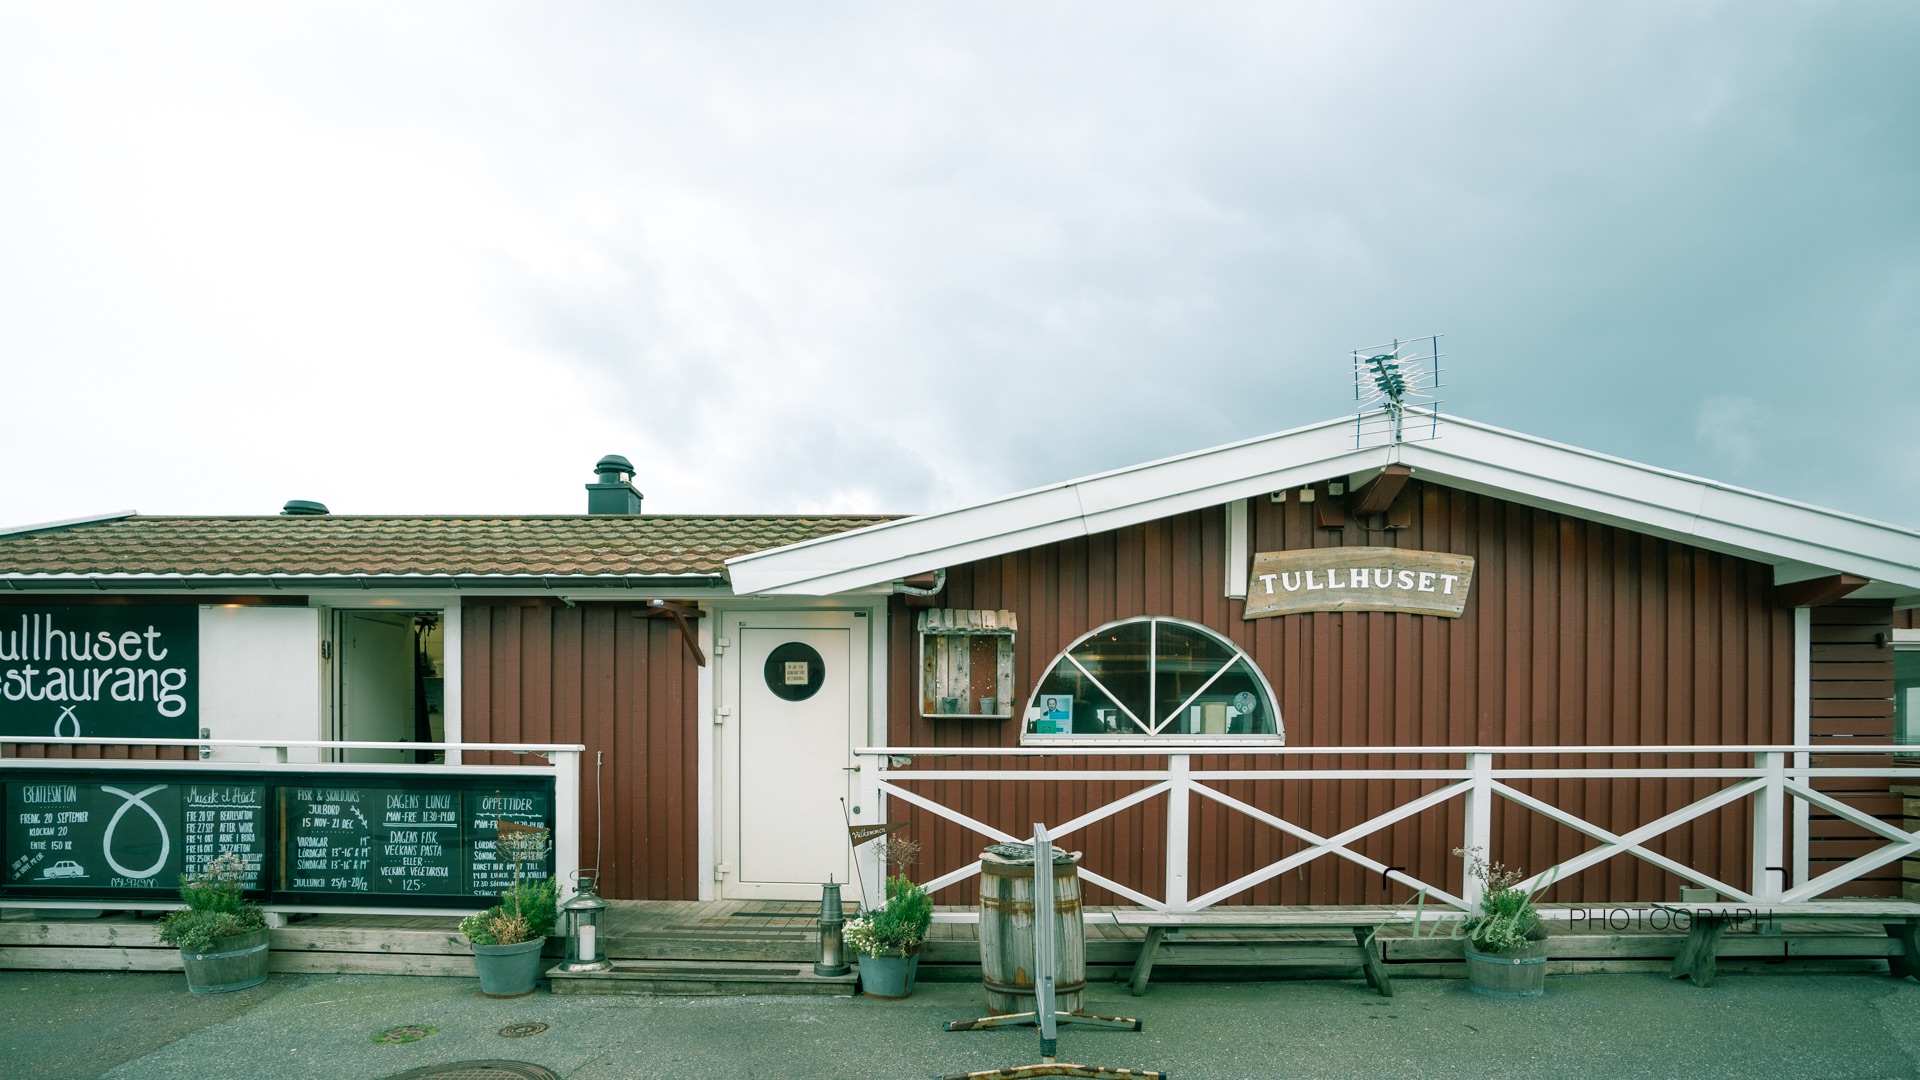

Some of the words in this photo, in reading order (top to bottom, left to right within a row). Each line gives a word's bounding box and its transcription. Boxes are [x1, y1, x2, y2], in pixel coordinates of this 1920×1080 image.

[1259, 568, 1459, 595] TULLHUSET
[0, 664, 187, 718] staurang
[23, 785, 77, 803] BEATLESAFTON
[187, 786, 219, 803] Musik
[297, 790, 313, 801] FISK
[316, 791, 323, 801] &
[386, 794, 420, 809] DAGENS
[425, 795, 451, 809] LUNCH
[482, 796, 533, 811] ÖPPETTIDER
[308, 804, 340, 815] JULBORD
[44, 813, 53, 824] 20
[57, 811, 89, 823] SEPTEMBER
[186, 811, 197, 822] FRE
[198, 811, 206, 822] 20
[206, 811, 216, 821] SEP
[220, 810, 253, 821] BEATLESAFTON
[386, 811, 417, 822] MÅN-FRE
[186, 823, 196, 833] FRE
[197, 823, 206, 833] 27
[205, 823, 215, 833] SEP
[219, 823, 236, 833] AFTER
[238, 823, 254, 833] WORK
[302, 818, 311, 827] 15
[332, 819, 340, 828] 21
[342, 819, 354, 829] DEC
[474, 819, 499, 831] MÅN-FR
[29, 827, 55, 837] KLOCKAN
[57, 826, 68, 836] 20
[186, 835, 196, 844] FRE
[204, 834, 214, 843] OKT
[219, 834, 233, 843] ARNE
[297, 836, 329, 847] VARDAGAR
[390, 831, 418, 844] DAGENS
[51, 841, 63, 850] 150
[65, 841, 73, 850] KR
[186, 845, 196, 854] FRE
[203, 844, 214, 853] OKT
[218, 844, 251, 853] JAZZAFTON
[384, 844, 418, 856] VECKANS
[420, 845, 442, 856] PASTA
[474, 840, 497, 850] LÖRDAG
[186, 854, 197, 863] FRE
[196, 854, 204, 863] 25
[203, 854, 214, 863] OKT
[298, 848, 327, 858] LÖRDAGAR
[354, 848, 359, 857] &
[474, 851, 497, 860] SÖNDAG
[185, 864, 196, 873] FRE
[297, 859, 327, 870] SÖNDAGAR
[353, 861, 358, 870] &
[473, 863, 491, 871] KÖKET
[506, 863, 523, 871] ÖPPT
[380, 866, 406, 876] VECKANS
[410, 866, 449, 877] VEGETARISKA
[293, 878, 326, 888] JULLUNCH
[473, 880, 488, 888] 17.30
[490, 880, 517, 888] SÖNDAGA
